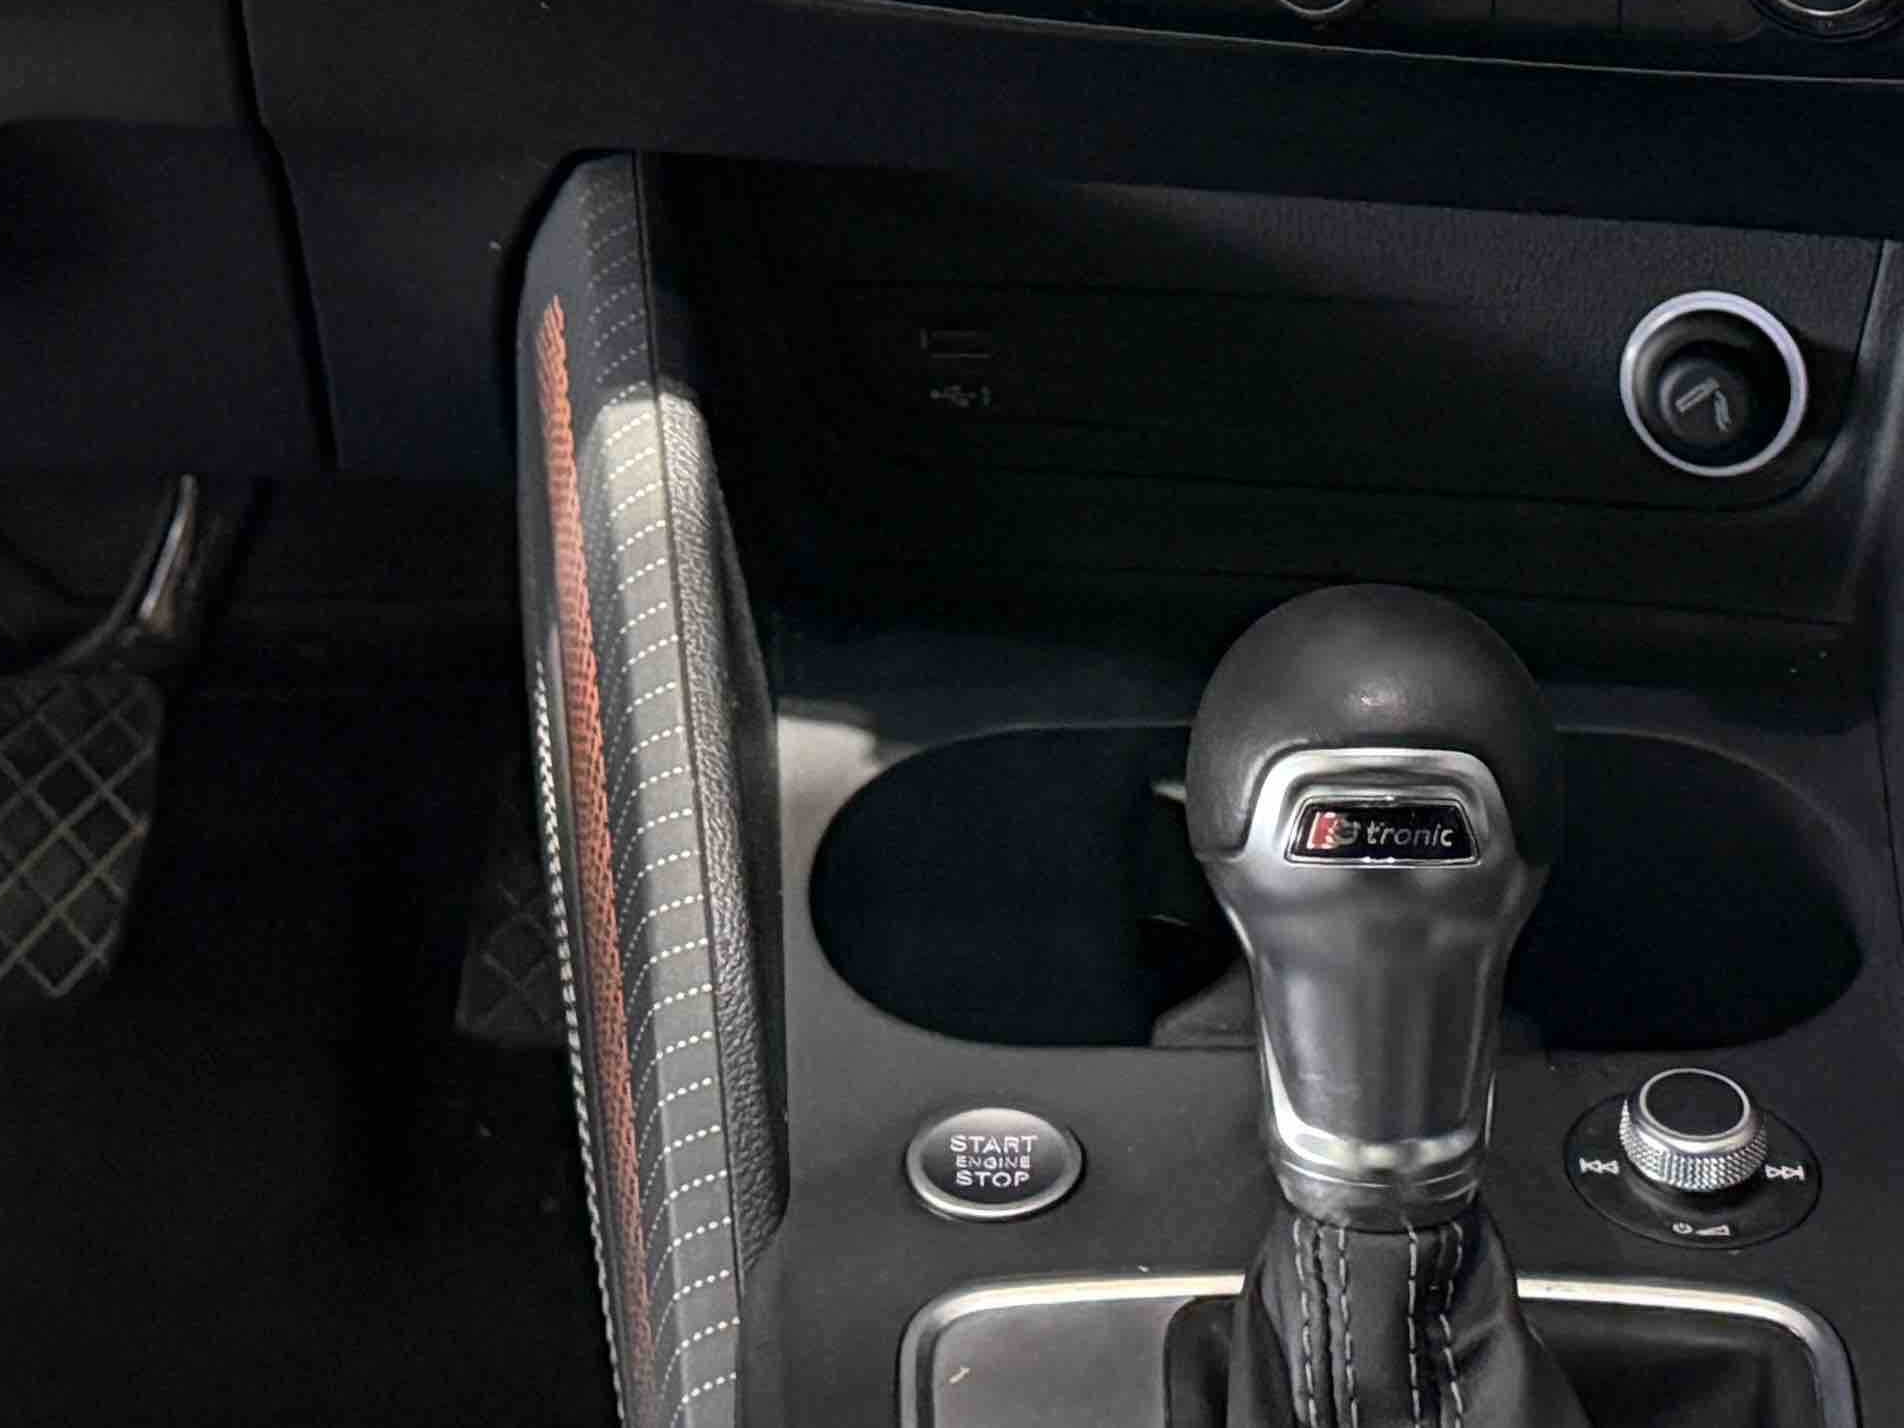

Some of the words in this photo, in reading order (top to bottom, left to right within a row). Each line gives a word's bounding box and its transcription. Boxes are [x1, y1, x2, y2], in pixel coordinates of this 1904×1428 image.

[1366, 819, 1454, 847] tronic
[949, 1134, 1039, 1154] START
[956, 1155, 1031, 1169] ENGINE
[956, 1169, 1031, 1187] STOP
